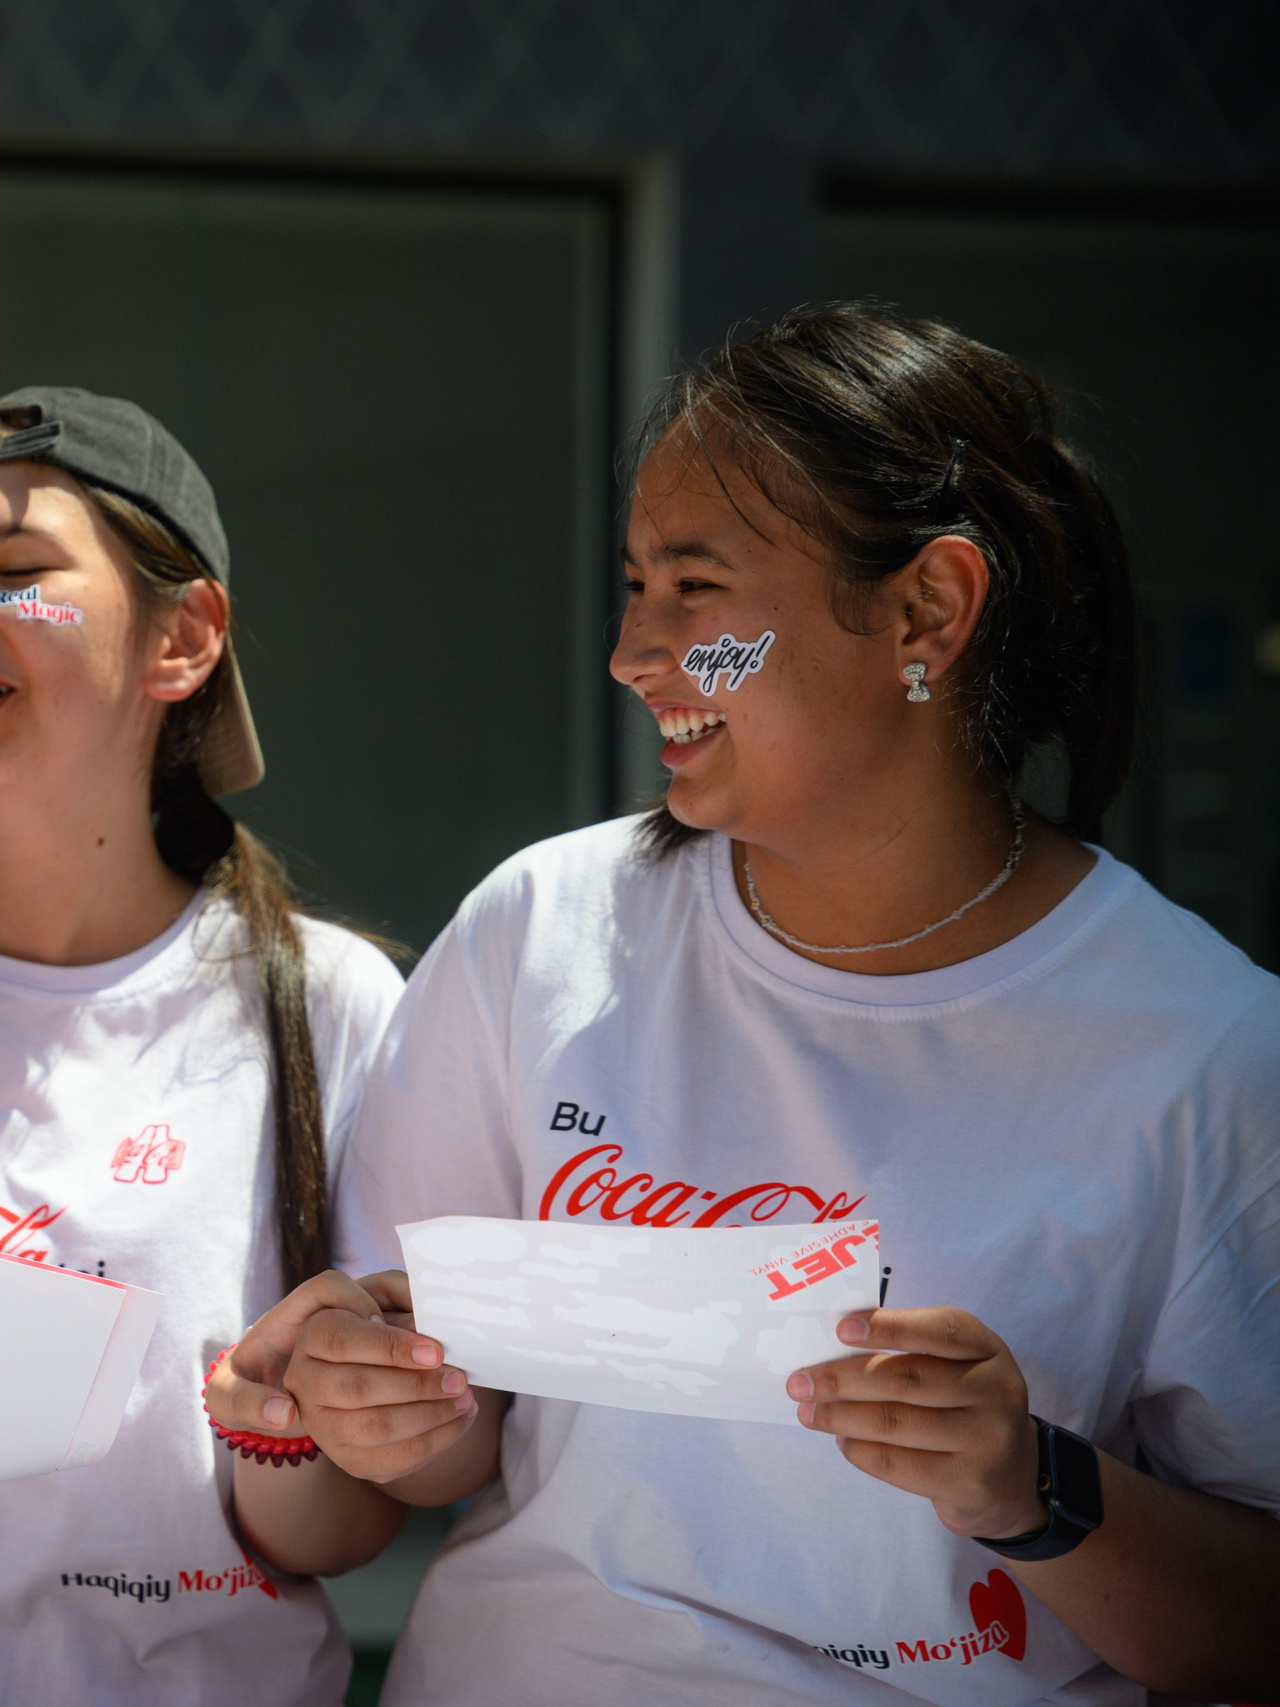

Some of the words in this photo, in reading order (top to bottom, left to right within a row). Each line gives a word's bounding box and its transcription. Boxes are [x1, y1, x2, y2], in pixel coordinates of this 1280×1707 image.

[18, 601, 80, 624] Magic
[684, 634, 771, 694] enjoy!
[549, 1101, 607, 1137] Bu
[790, 1223, 856, 1259] ADHESIVE
[60, 1573, 171, 1603] Haqiqiy
[813, 1643, 891, 1669] iqiy
[895, 1622, 1009, 1666] Mo‘jiza
